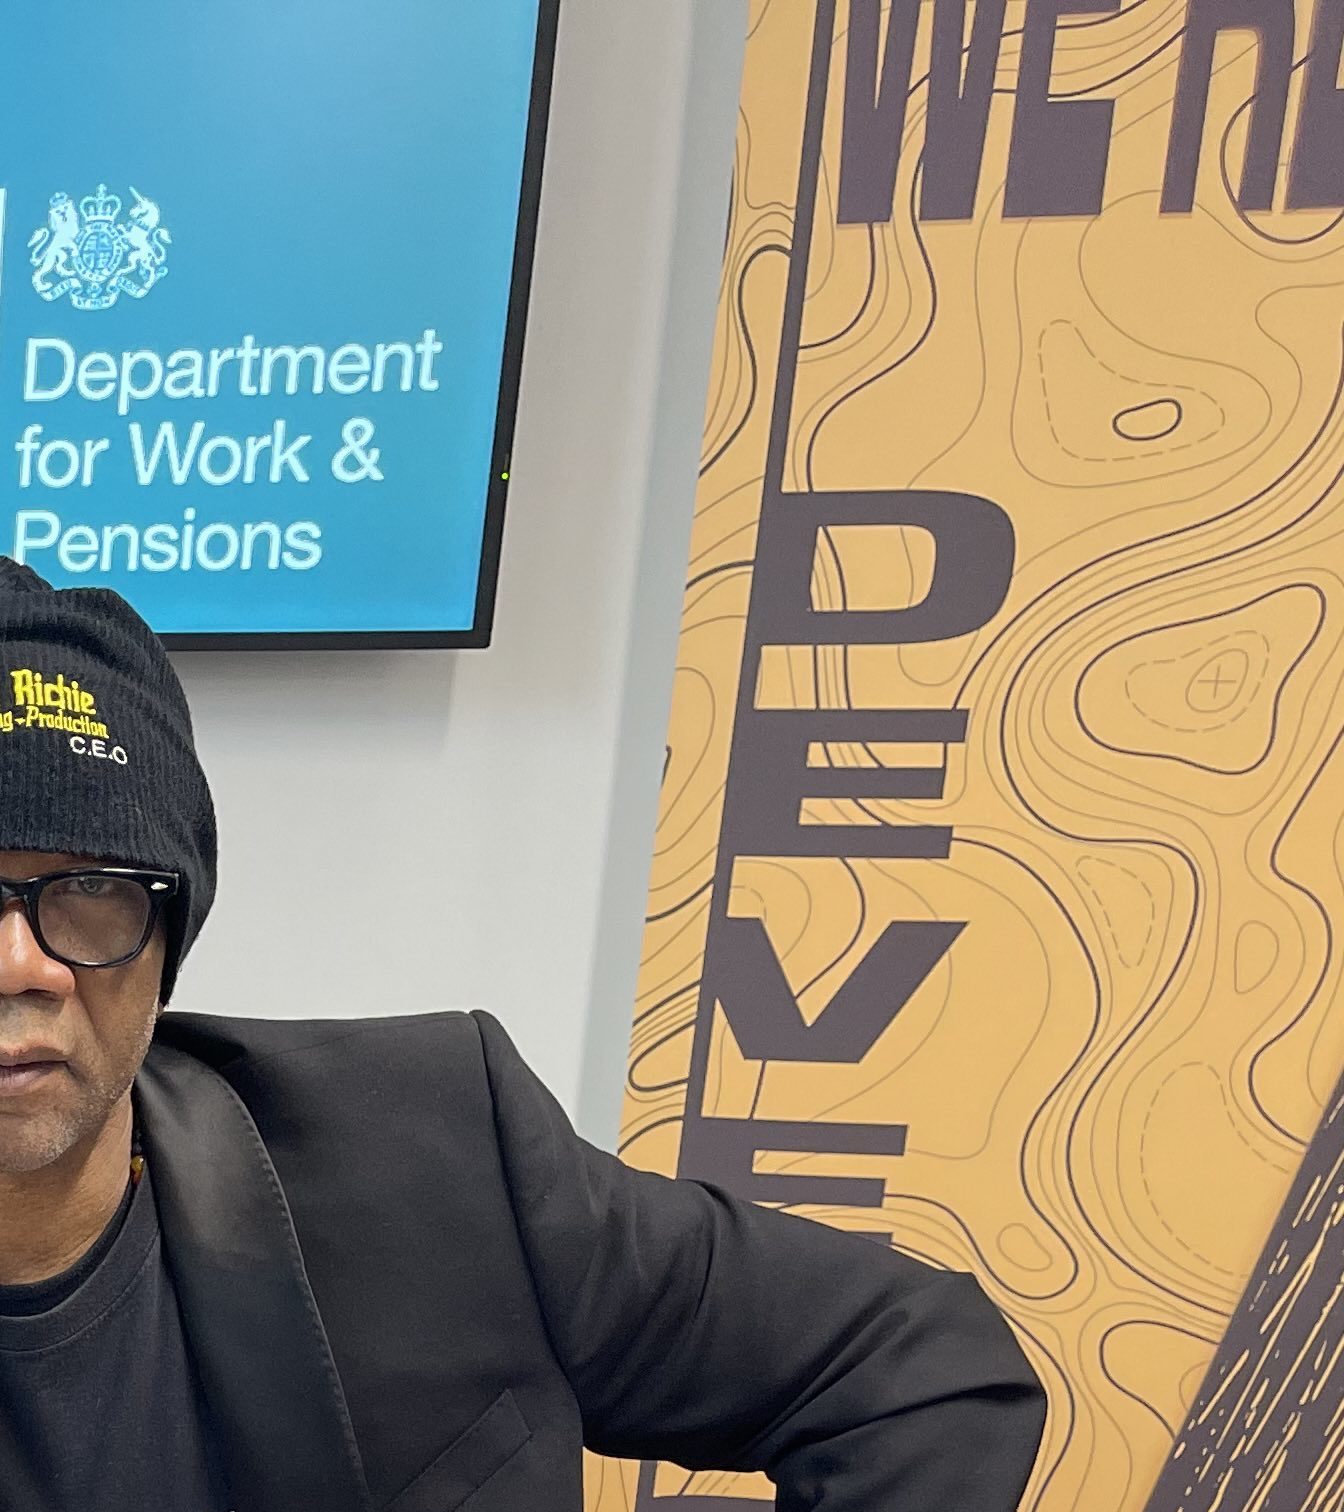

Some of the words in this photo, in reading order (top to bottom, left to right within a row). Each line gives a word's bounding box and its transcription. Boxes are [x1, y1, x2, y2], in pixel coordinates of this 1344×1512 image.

[23, 329, 443, 416] Department
[15, 424, 109, 489] for
[128, 419, 313, 486] Work
[331, 417, 385, 483] &
[14, 508, 323, 573] Pensions
[10, 668, 97, 715] Richie
[25, 706, 110, 739] Production
[69, 735, 128, 765] C.E.O
